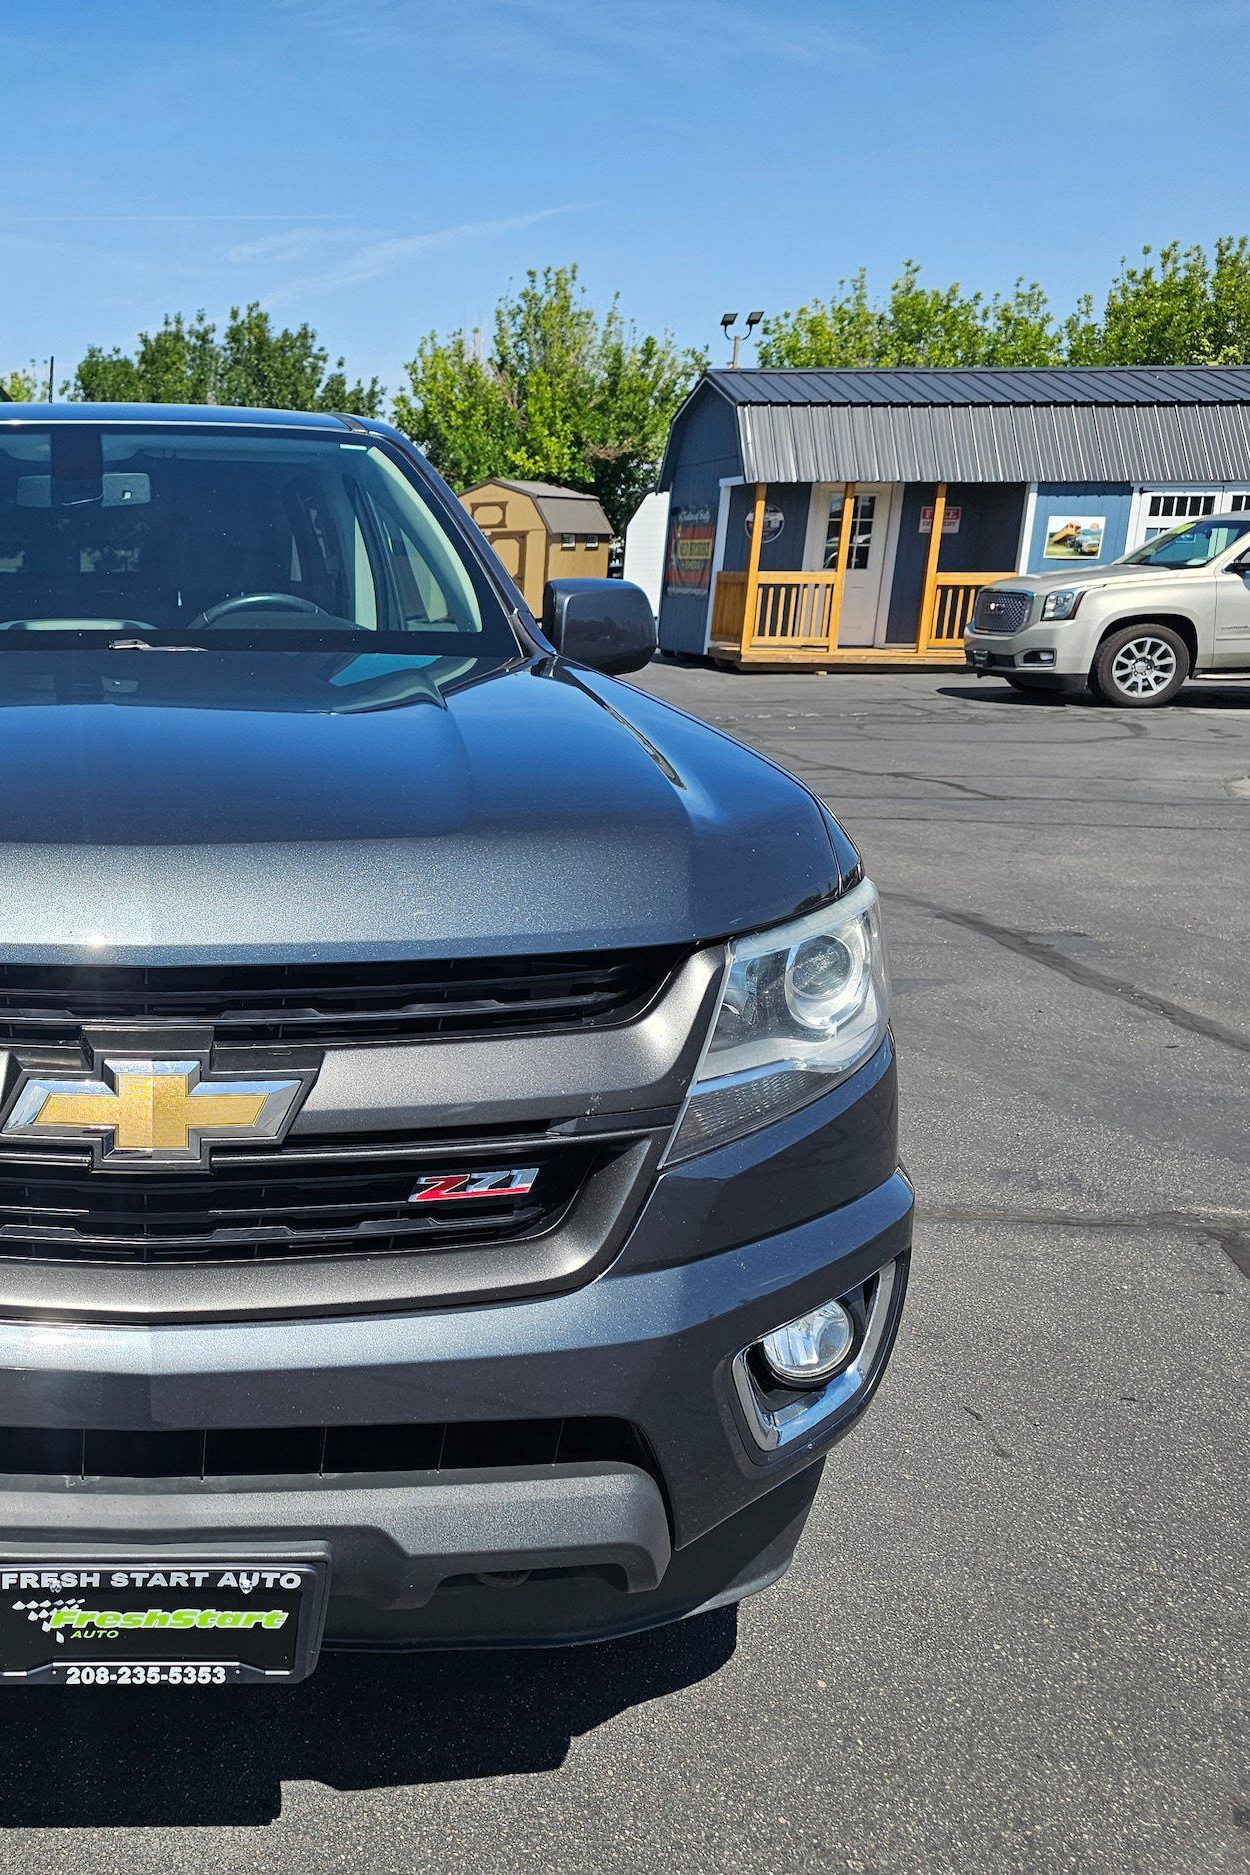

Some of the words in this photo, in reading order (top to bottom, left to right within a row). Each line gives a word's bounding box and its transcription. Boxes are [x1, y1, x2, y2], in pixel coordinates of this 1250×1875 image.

[408, 1168, 539, 1202] Z71
[1, 1572, 101, 1590] FRESH
[110, 1572, 209, 1588] START
[217, 1572, 302, 1590] AUTO
[50, 1608, 289, 1630] FreshStart
[70, 1630, 119, 1639] AUTO
[65, 1666, 227, 1685] 208-235-5353
